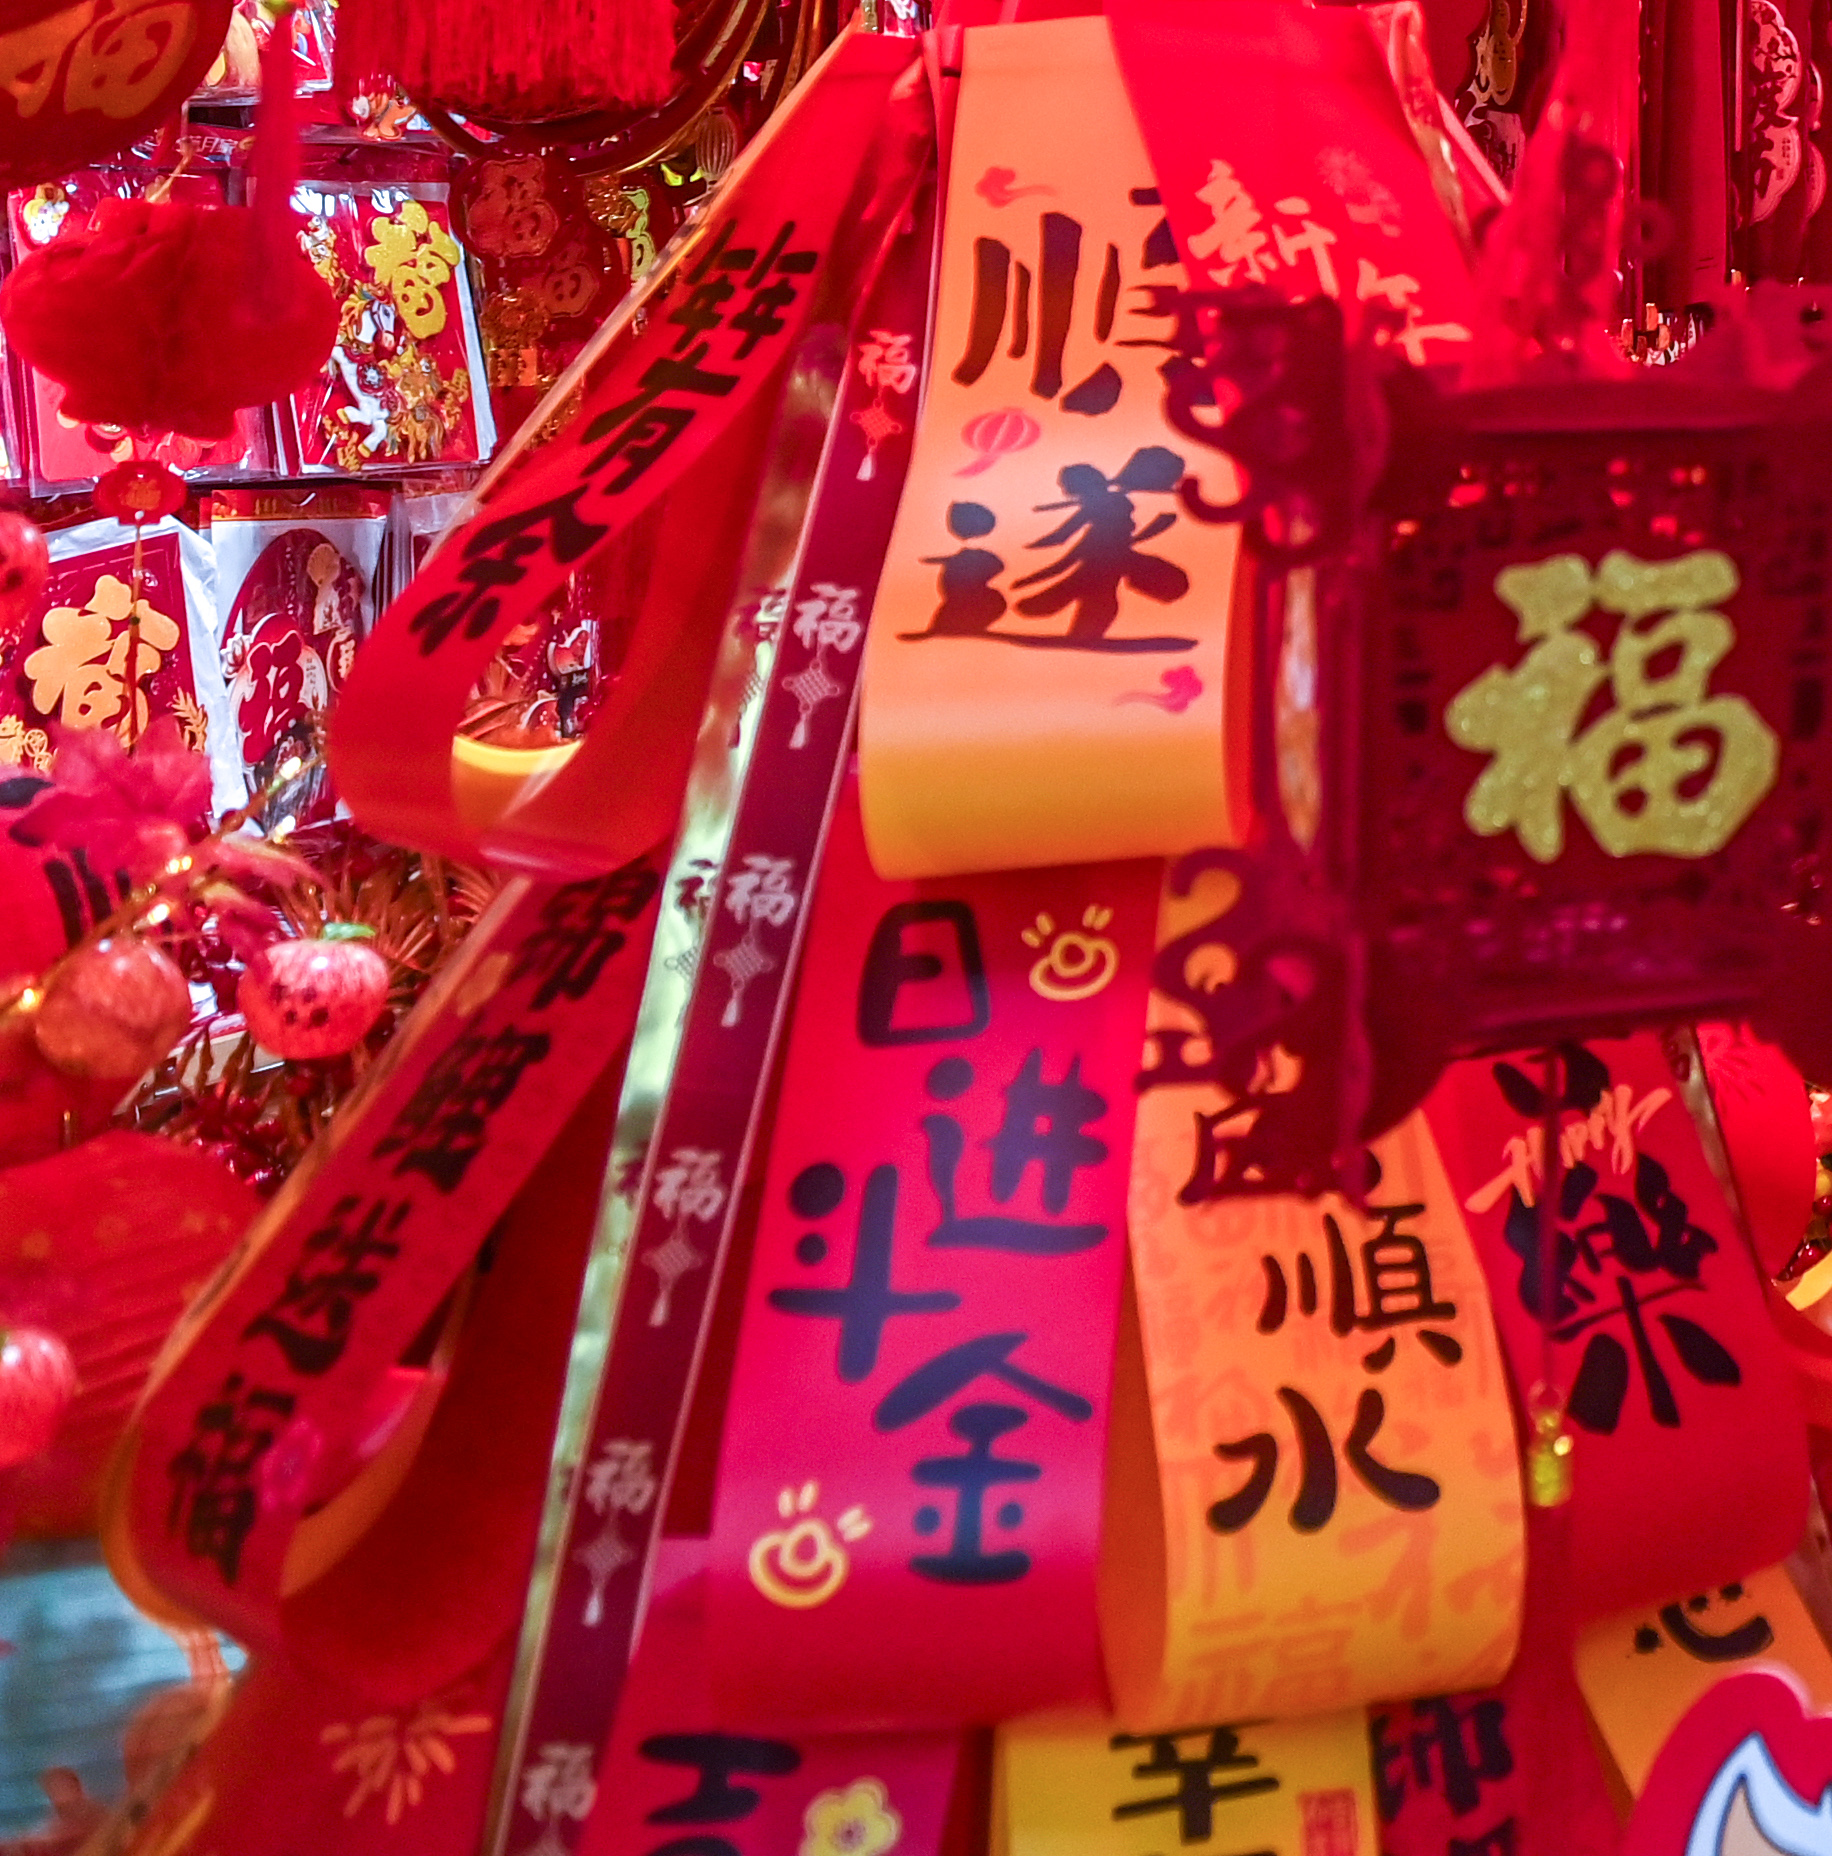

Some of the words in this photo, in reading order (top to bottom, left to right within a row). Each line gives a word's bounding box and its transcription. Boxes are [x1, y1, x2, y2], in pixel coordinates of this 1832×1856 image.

[858, 330, 917, 394] 福
[794, 582, 865, 651] 福
[1444, 549, 1781, 863] 福
[724, 855, 799, 927] 福
[651, 1147, 725, 1223] 福
[769, 900, 1109, 1587] 日进斗金
[583, 1438, 656, 1515] 福
[522, 1741, 596, 1822] 福
